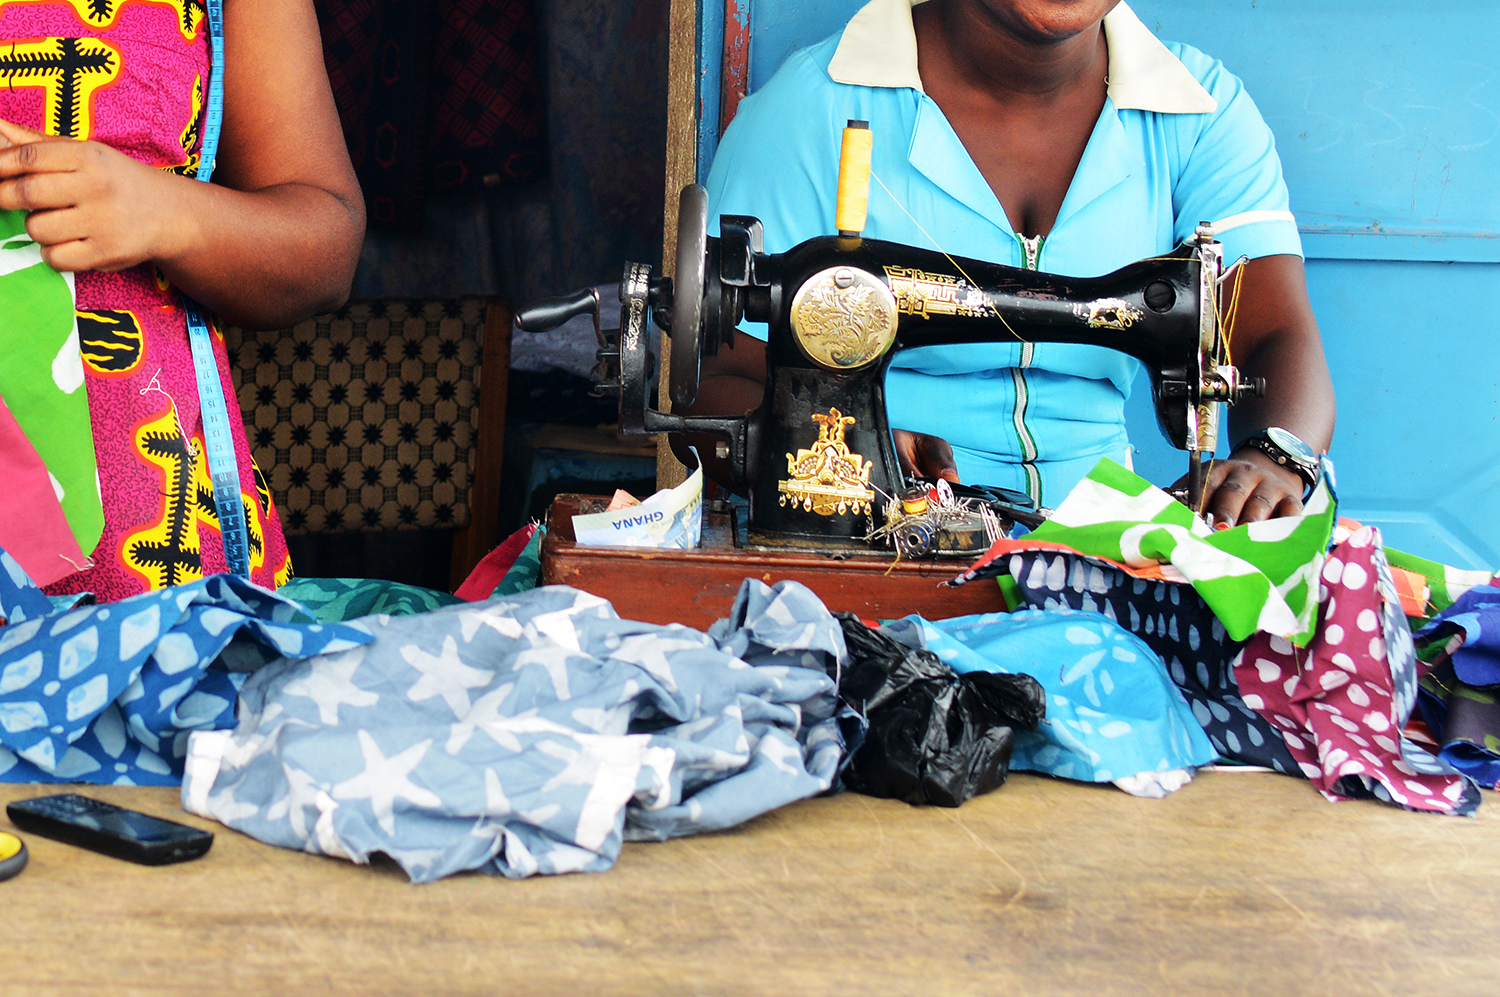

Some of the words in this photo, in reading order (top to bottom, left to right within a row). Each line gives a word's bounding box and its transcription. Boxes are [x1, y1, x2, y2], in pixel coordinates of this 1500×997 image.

[203, 371, 210, 379] 17
[205, 385, 213, 393] 16
[208, 400, 216, 408] 15
[211, 415, 218, 423] 14
[213, 429, 220, 437] 13
[219, 473, 228, 482] 10
[223, 488, 230, 497] 9
[225, 502, 232, 512] 8
[228, 517, 234, 526] 7
[612, 511, 664, 530] GHANA
